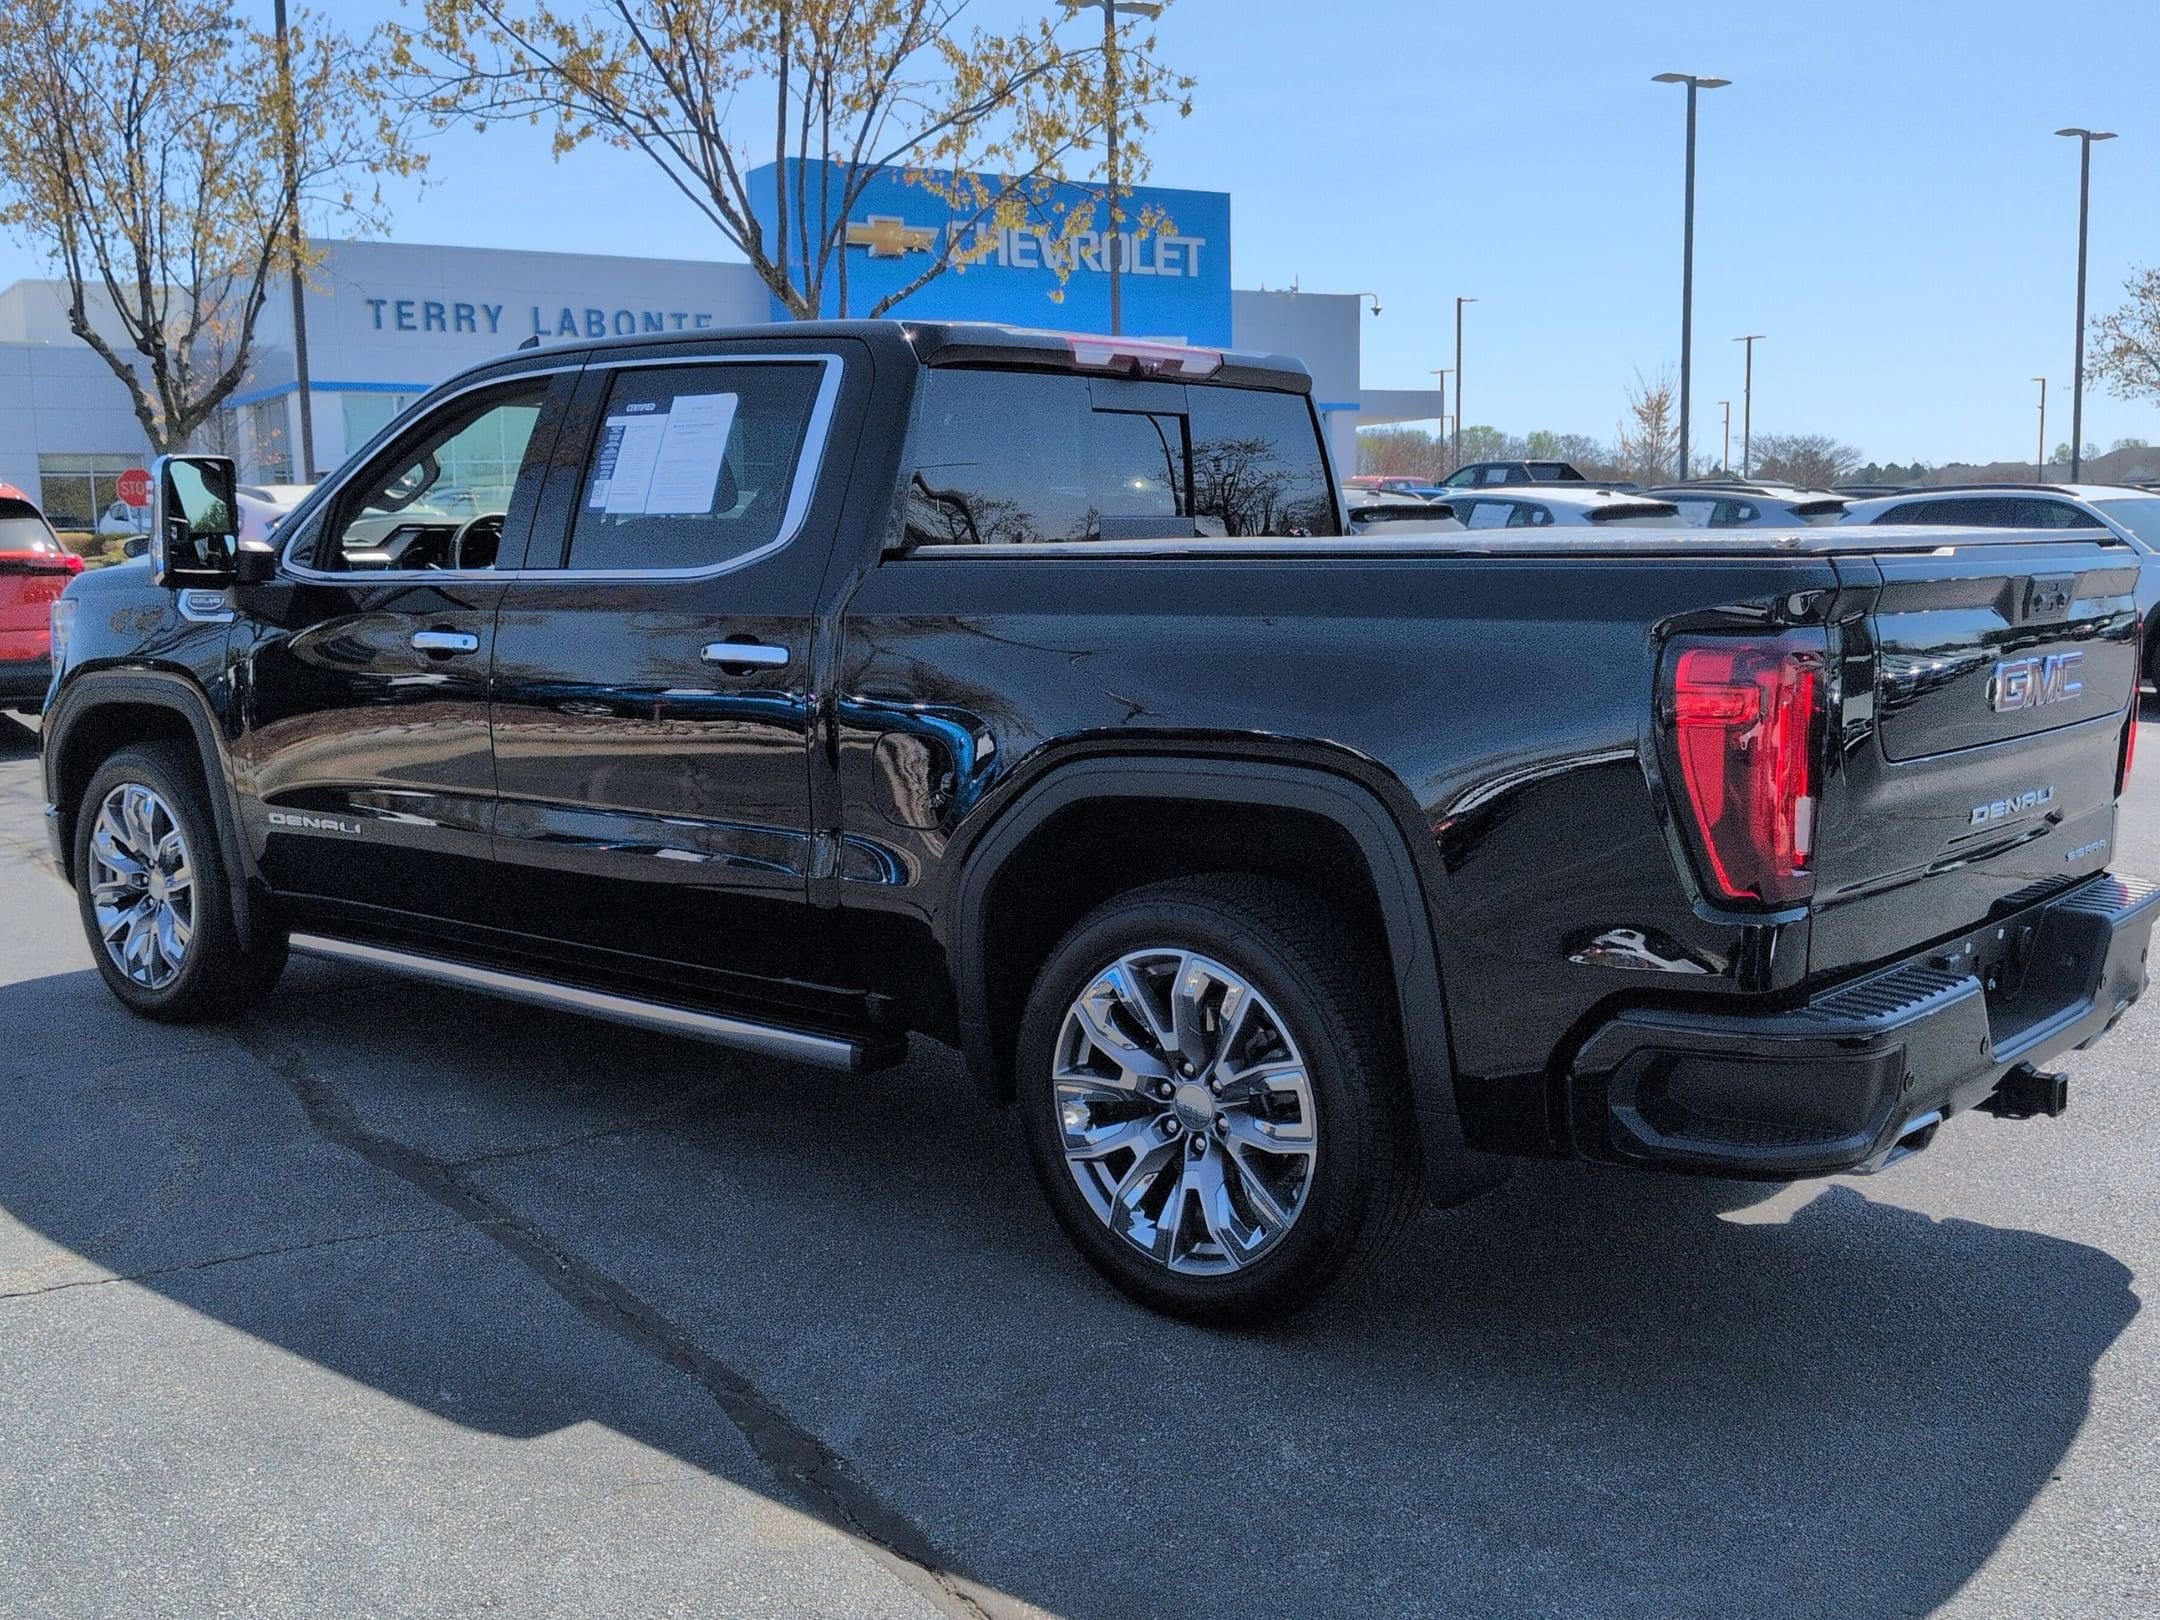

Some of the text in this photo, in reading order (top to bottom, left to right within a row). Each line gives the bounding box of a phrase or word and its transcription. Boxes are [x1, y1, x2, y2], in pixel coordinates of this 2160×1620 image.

[946, 220, 1206, 278] CHEVROLET
[366, 299, 503, 333] TERRY
[120, 480, 146, 496] STO
[1987, 651, 2083, 713] GMC
[1970, 786, 2054, 825] DENALI
[268, 812, 361, 835] DENALI
[2065, 838, 2108, 862] SIERRA
